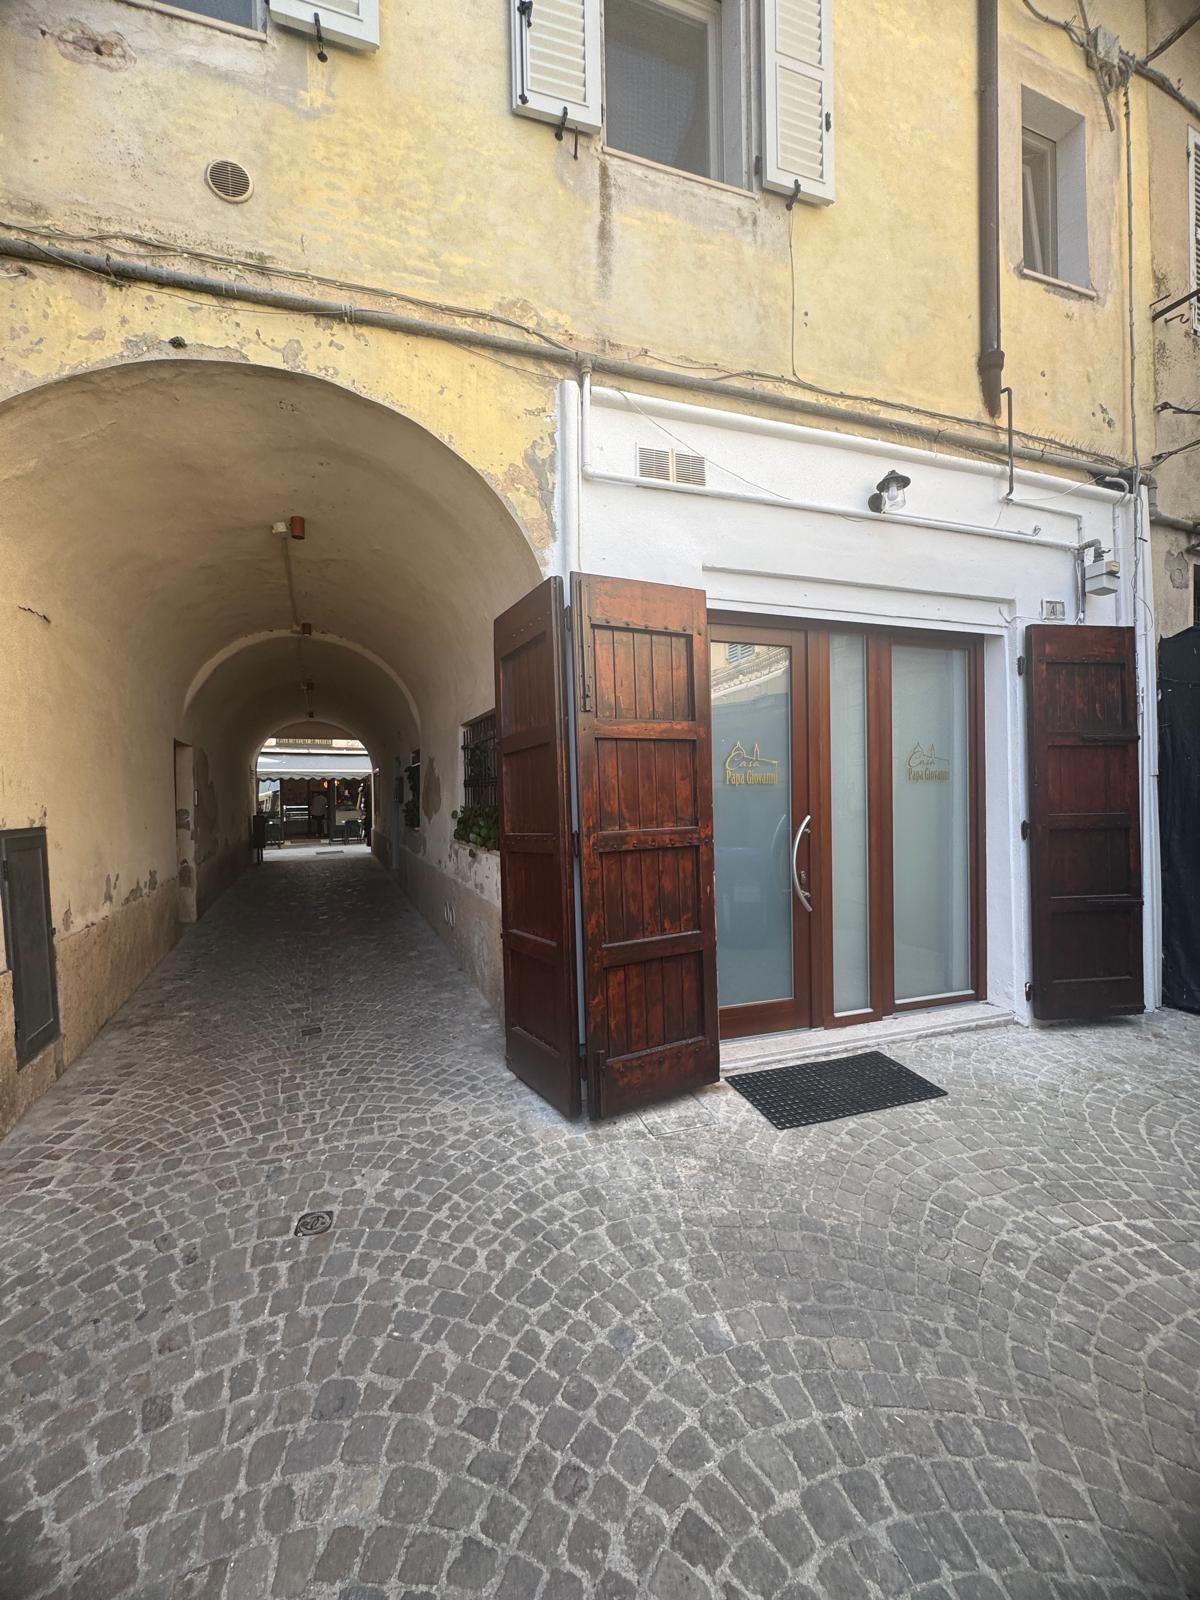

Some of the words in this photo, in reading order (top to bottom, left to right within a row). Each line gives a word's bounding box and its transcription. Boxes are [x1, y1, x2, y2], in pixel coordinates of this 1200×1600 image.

[726, 750, 760, 770] Casa
[726, 769, 745, 787] Papa
[746, 769, 778, 785] Giovanni
[908, 767, 923, 783] Papa
